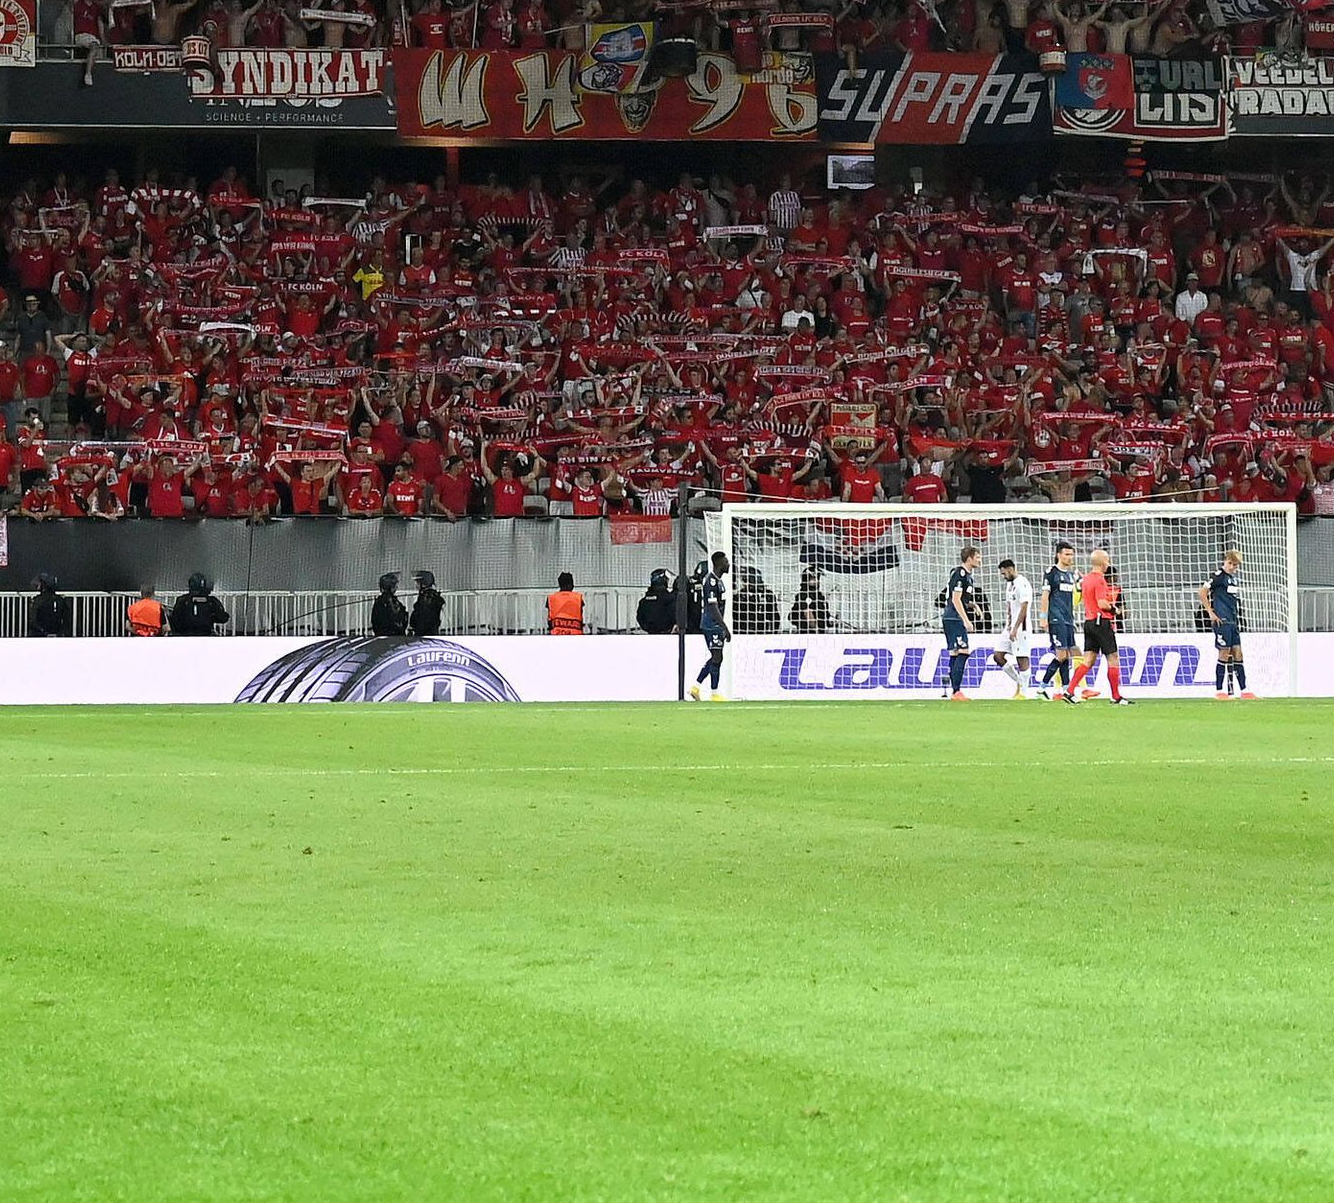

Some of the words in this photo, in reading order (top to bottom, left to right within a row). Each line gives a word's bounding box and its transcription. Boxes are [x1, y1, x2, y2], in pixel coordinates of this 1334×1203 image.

[191, 50, 384, 97] SYNDIKAT
[821, 55, 1046, 137] SUPRAS
[206, 111, 252, 122] SCIENCE
[265, 111, 344, 122] PERFORMANCE
[299, 283, 324, 293] KÖLN
[407, 653, 470, 667] Laufenn
